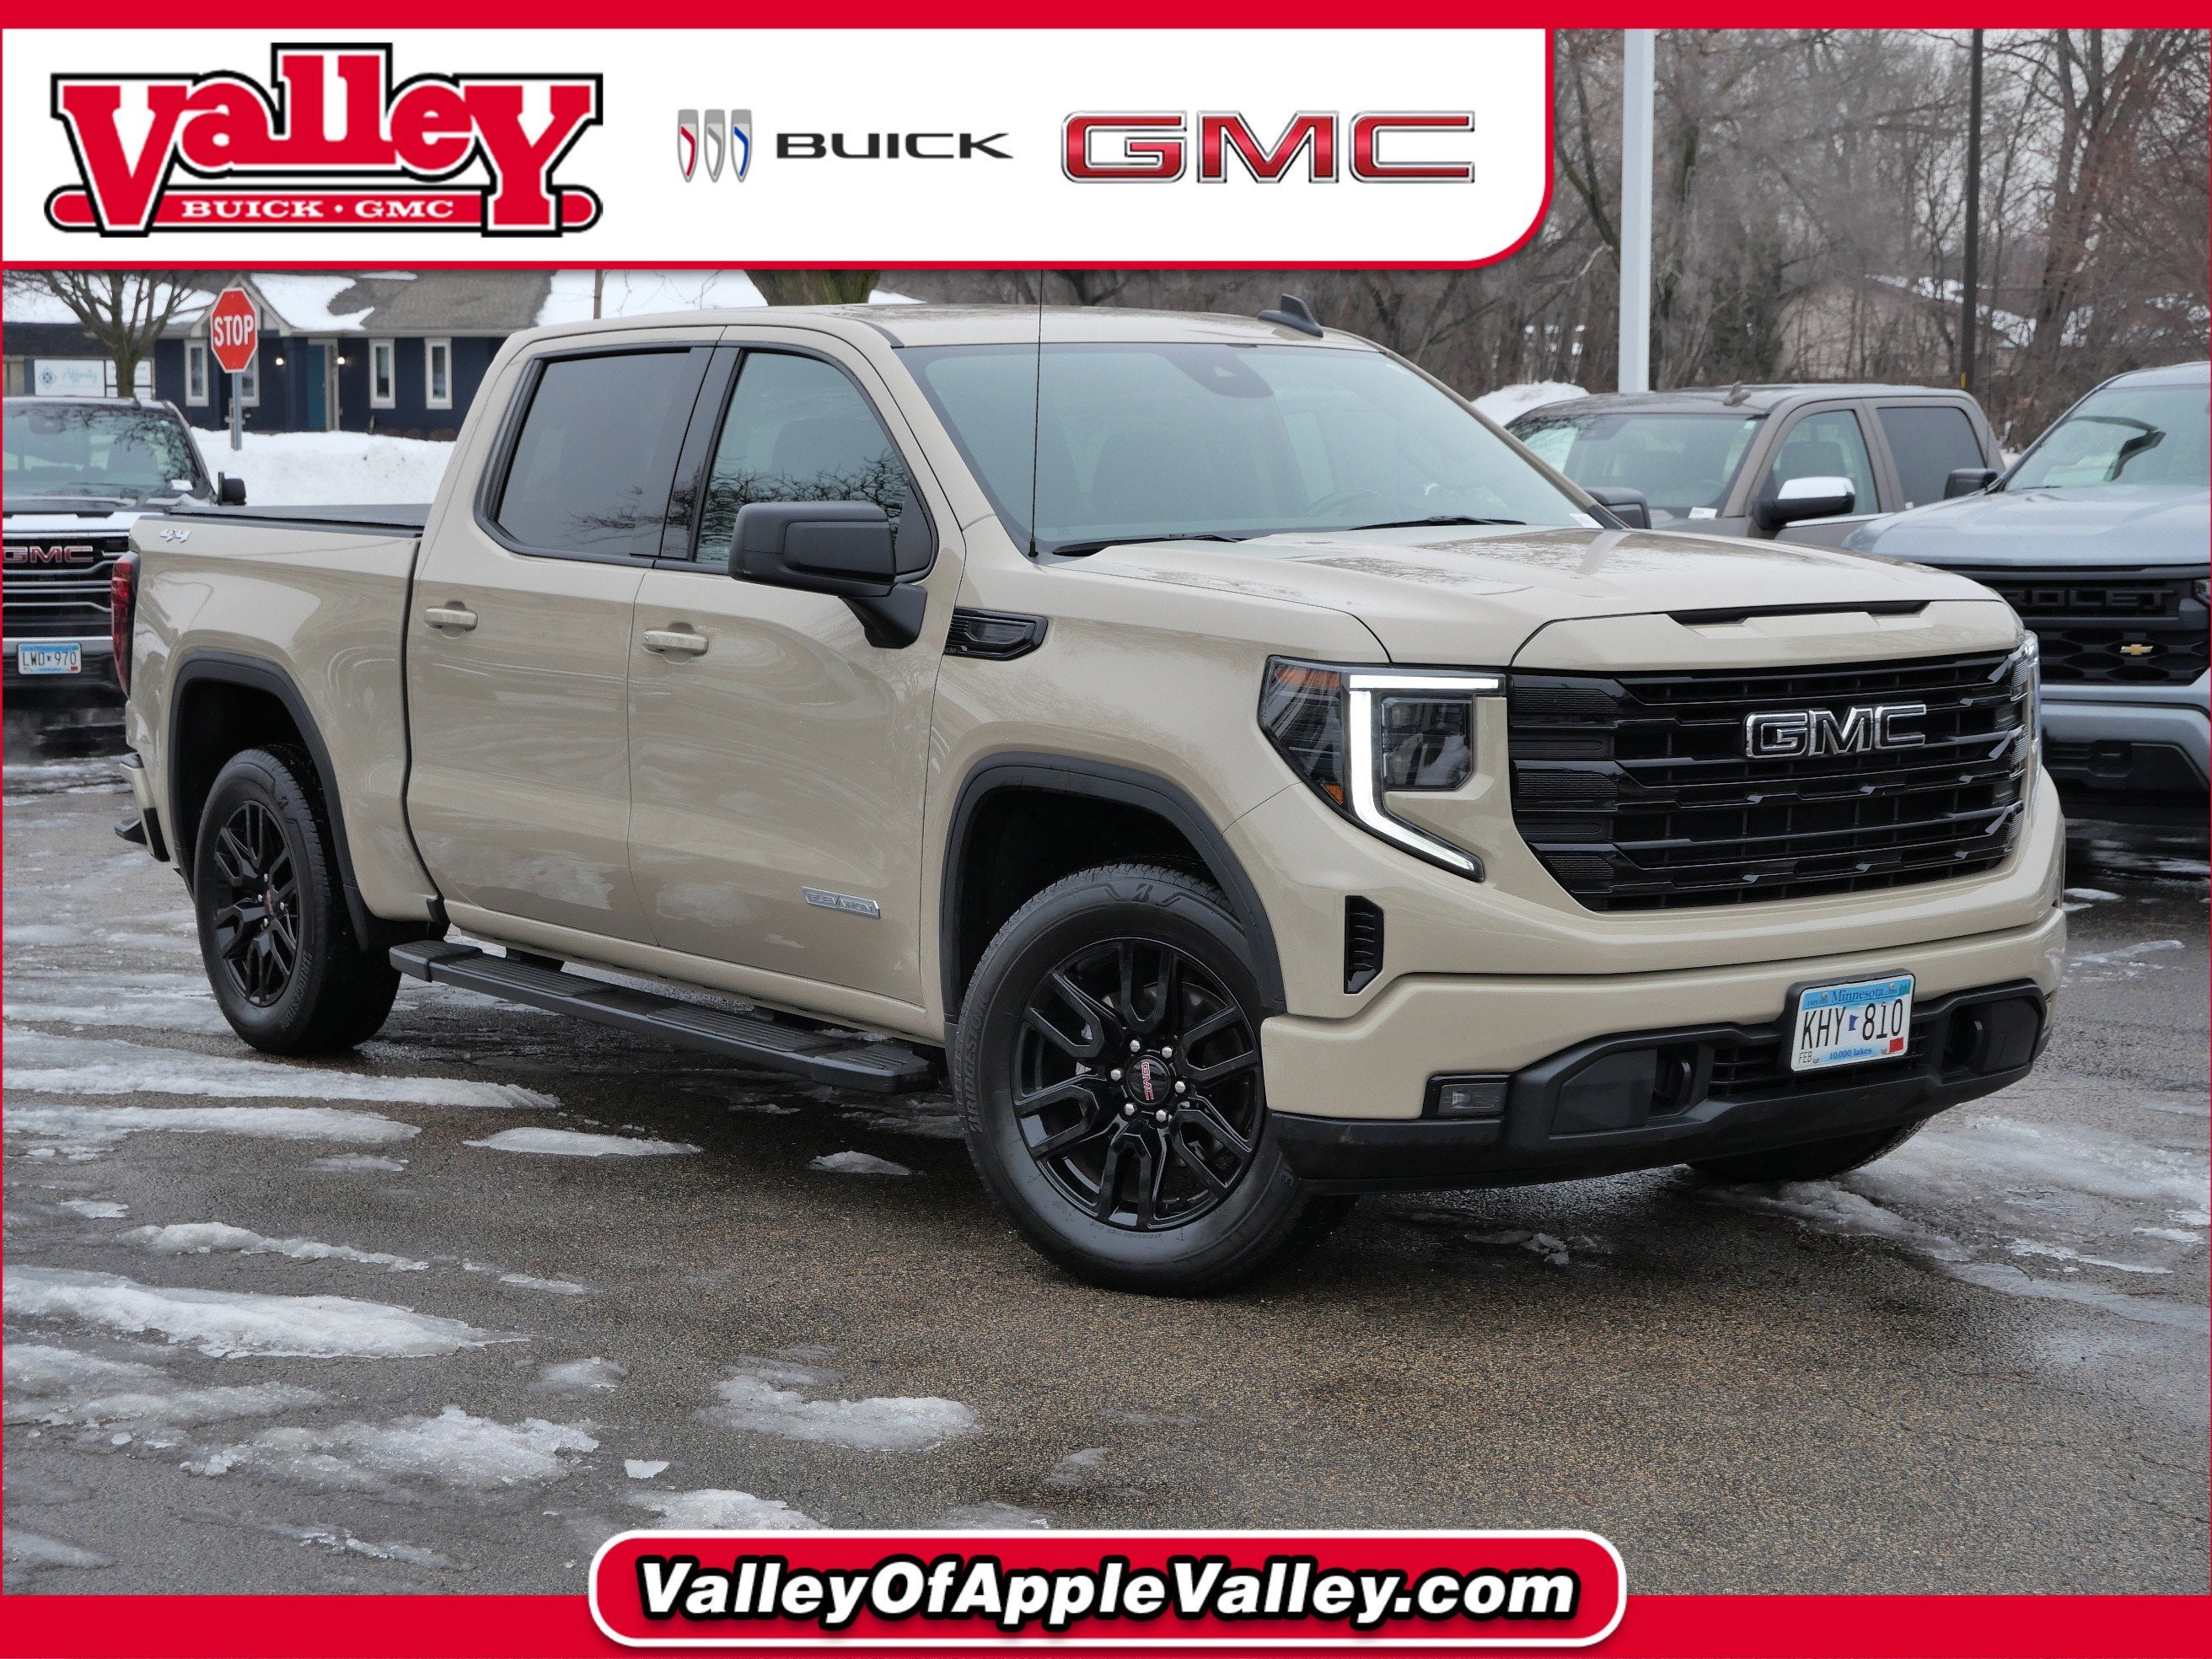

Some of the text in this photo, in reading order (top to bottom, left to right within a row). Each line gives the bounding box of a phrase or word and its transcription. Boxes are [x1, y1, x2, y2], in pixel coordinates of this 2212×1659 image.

[213, 314, 255, 347] STOP
[3, 545, 94, 564] GMC
[22, 652, 77, 666] LWD 970
[1745, 704, 1927, 759] GMC
[1801, 998, 1903, 1050] KHY 810
[1798, 1050, 1813, 1064] FEB
[1853, 1047, 1872, 1057] lakes
[1141, 1061, 1154, 1102] GMC
